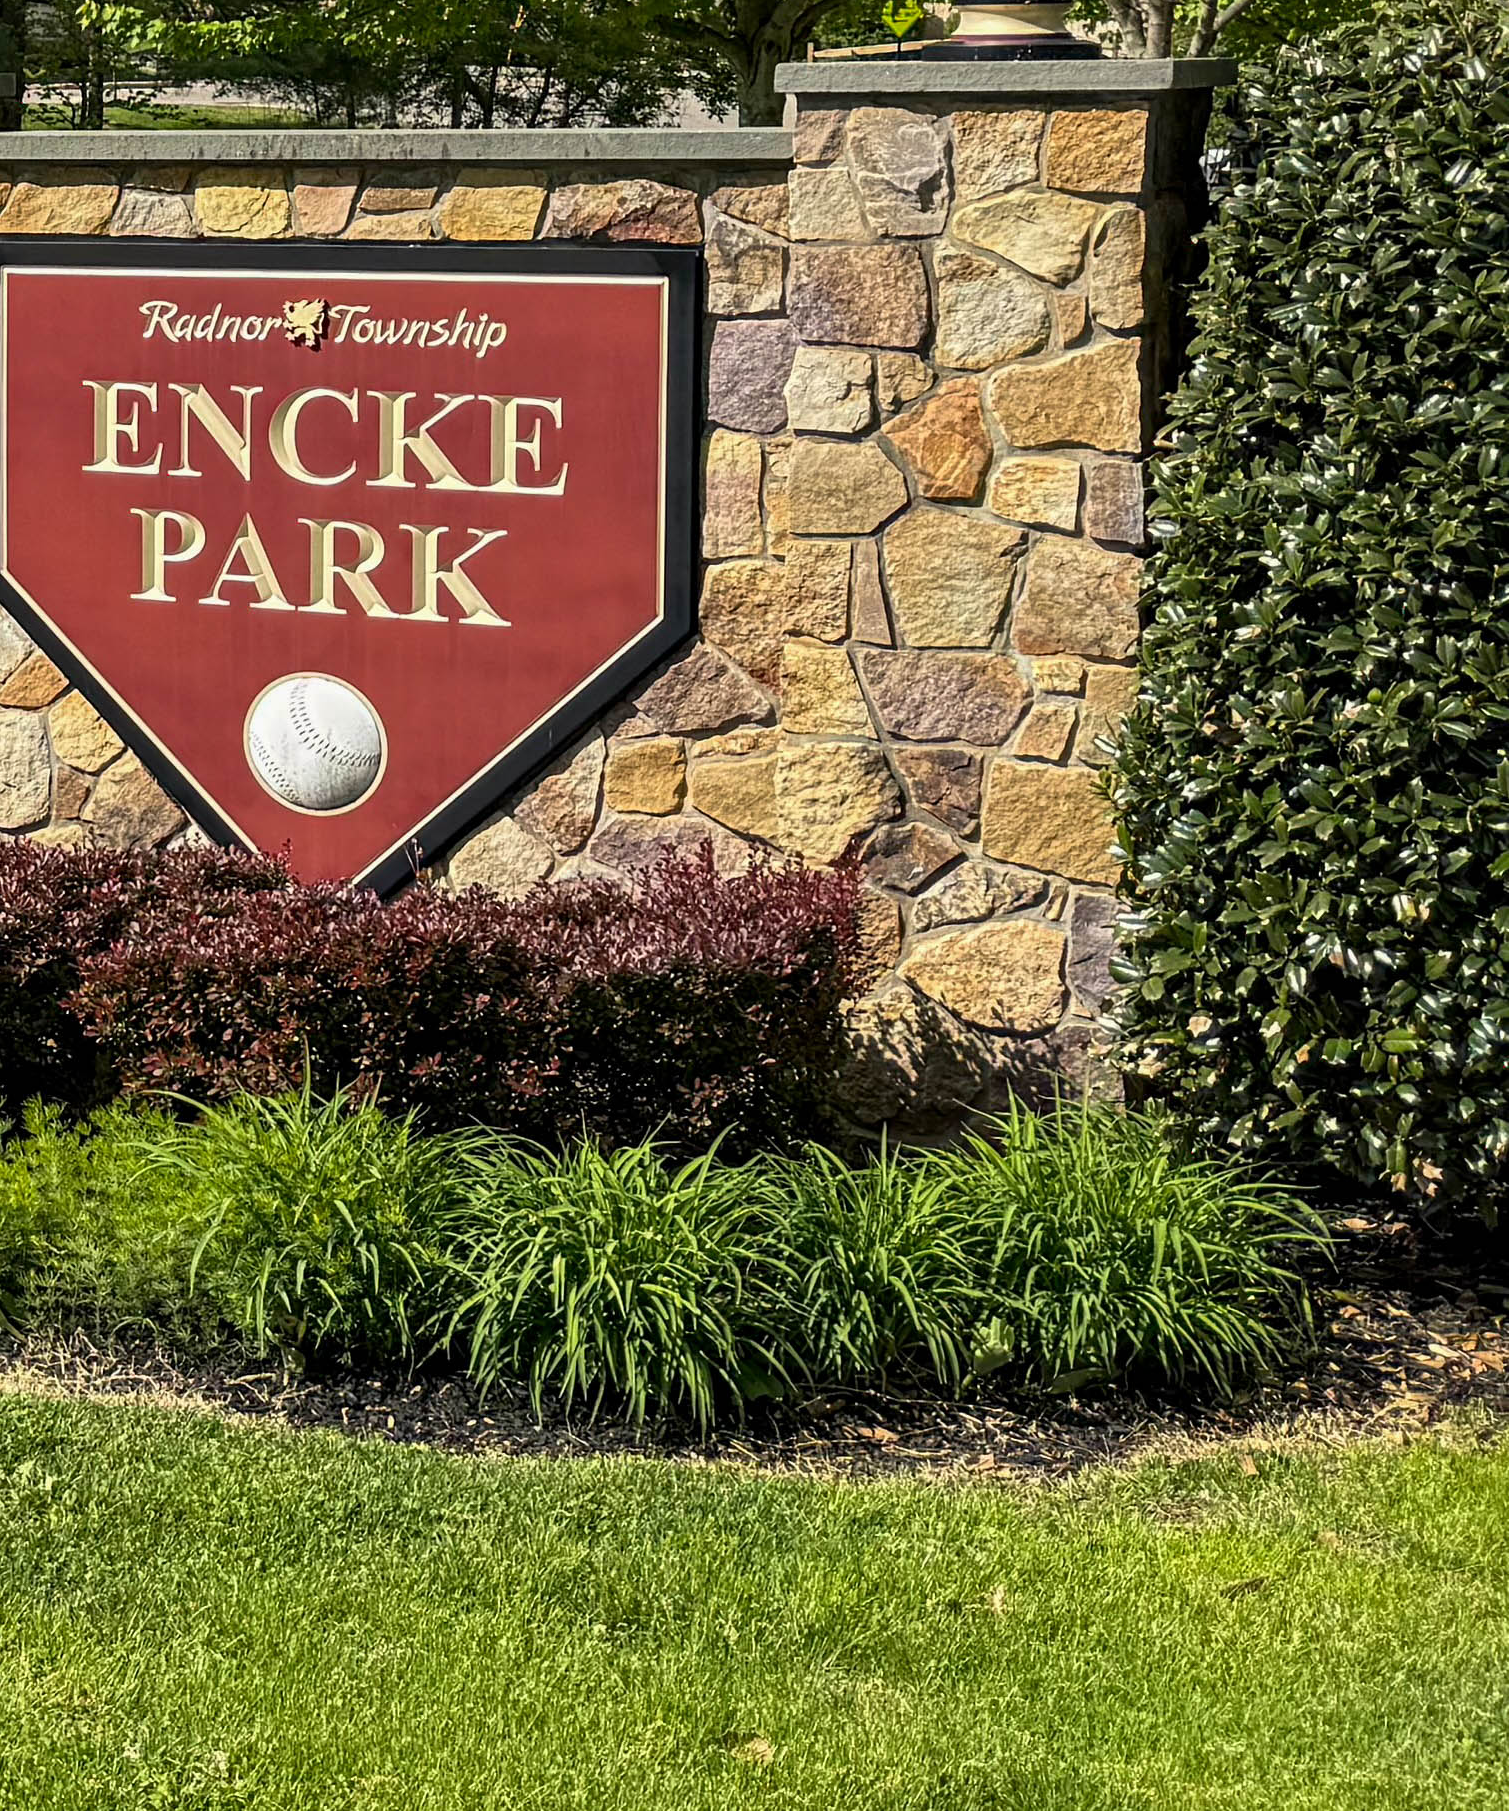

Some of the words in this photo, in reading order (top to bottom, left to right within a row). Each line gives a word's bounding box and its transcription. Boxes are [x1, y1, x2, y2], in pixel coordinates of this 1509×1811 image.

[139, 300, 282, 343] Radnor
[327, 304, 507, 358] Township
[82, 380, 569, 496] ENCKE
[130, 507, 512, 627] PARK
